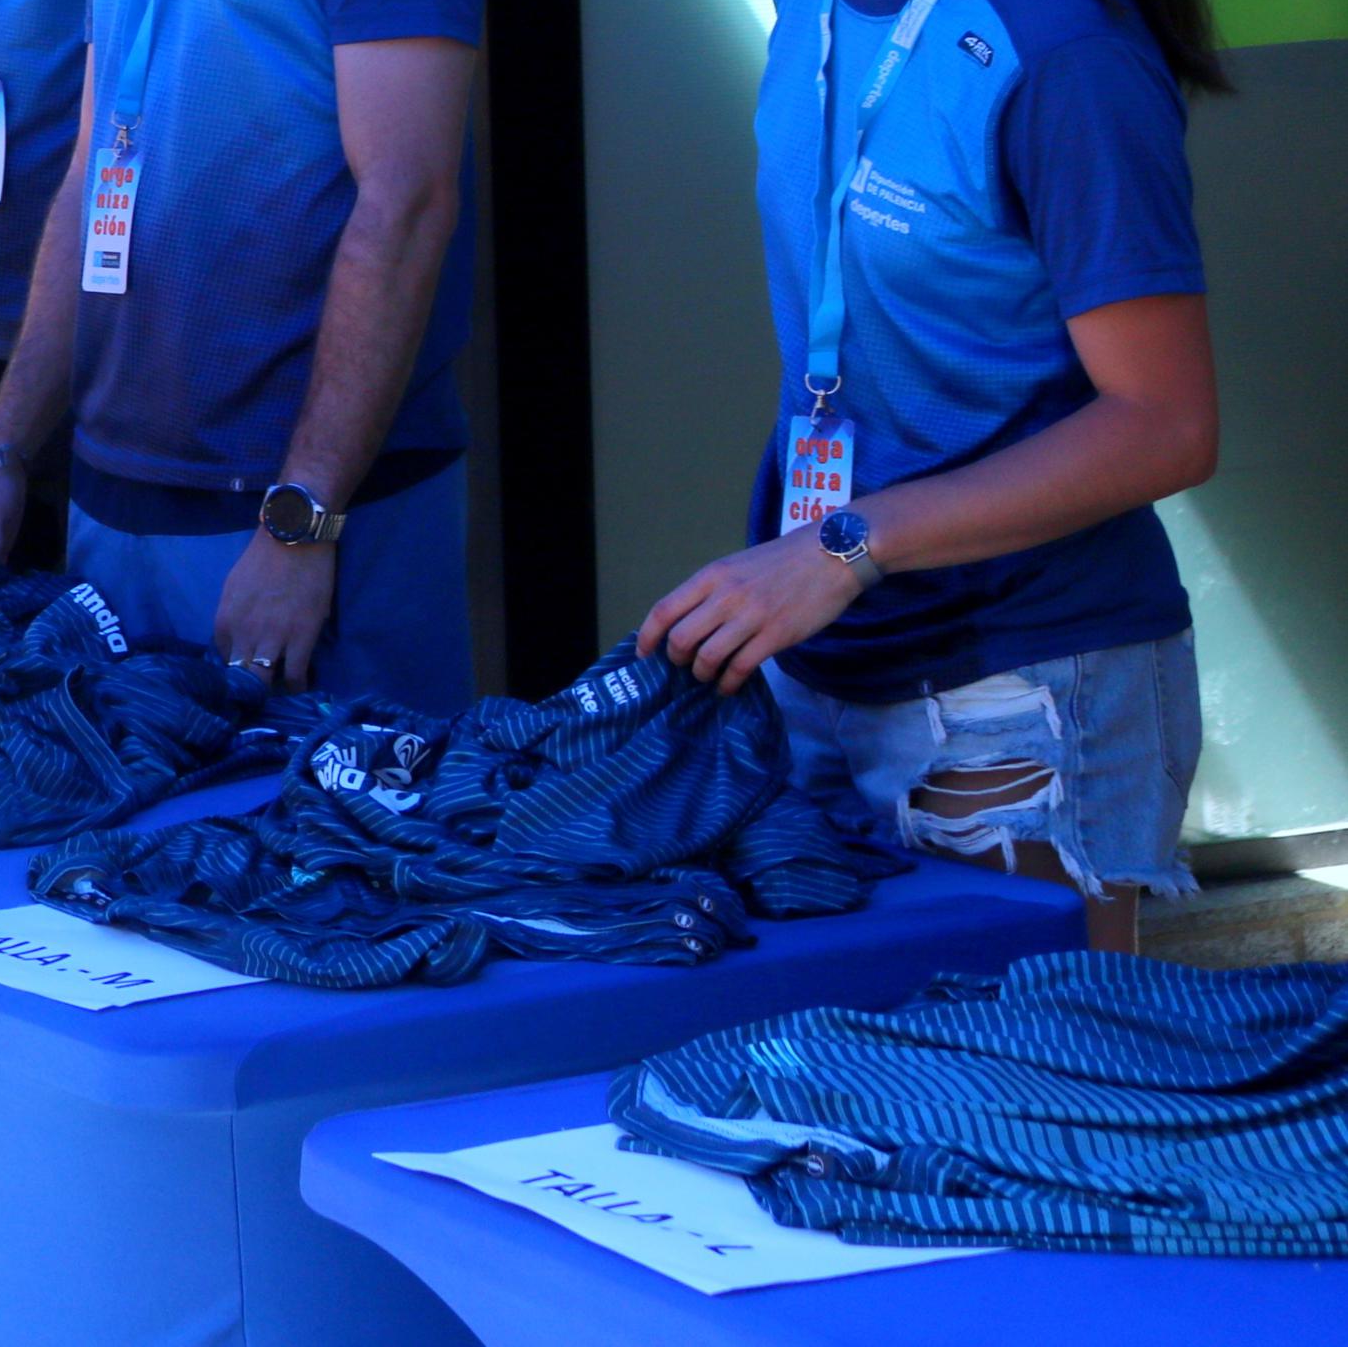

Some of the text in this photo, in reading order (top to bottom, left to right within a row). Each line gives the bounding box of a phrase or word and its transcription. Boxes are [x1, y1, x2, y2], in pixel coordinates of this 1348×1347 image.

[101, 166, 134, 188] orga
[96, 189, 130, 209] niza
[878, 187, 926, 214] PALENCIA
[93, 214, 127, 236] ción
[850, 198, 910, 234] deportes
[795, 437, 844, 464] orga
[792, 464, 842, 492] niza
